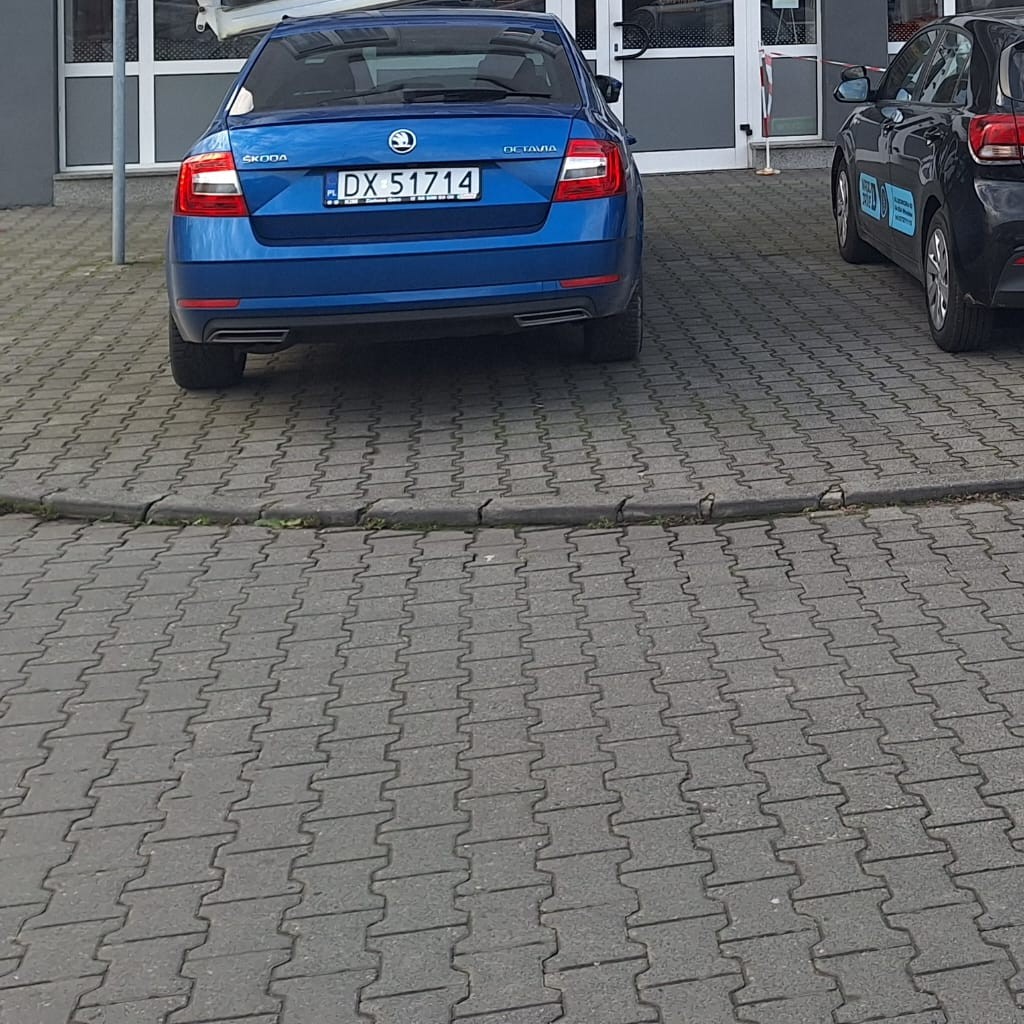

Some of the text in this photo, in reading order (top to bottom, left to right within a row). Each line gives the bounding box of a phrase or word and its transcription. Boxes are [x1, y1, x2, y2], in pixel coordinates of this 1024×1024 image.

[503, 144, 558, 154] OCTAVIA
[344, 170, 472, 197] DX 51714
[327, 189, 336, 197] PL
